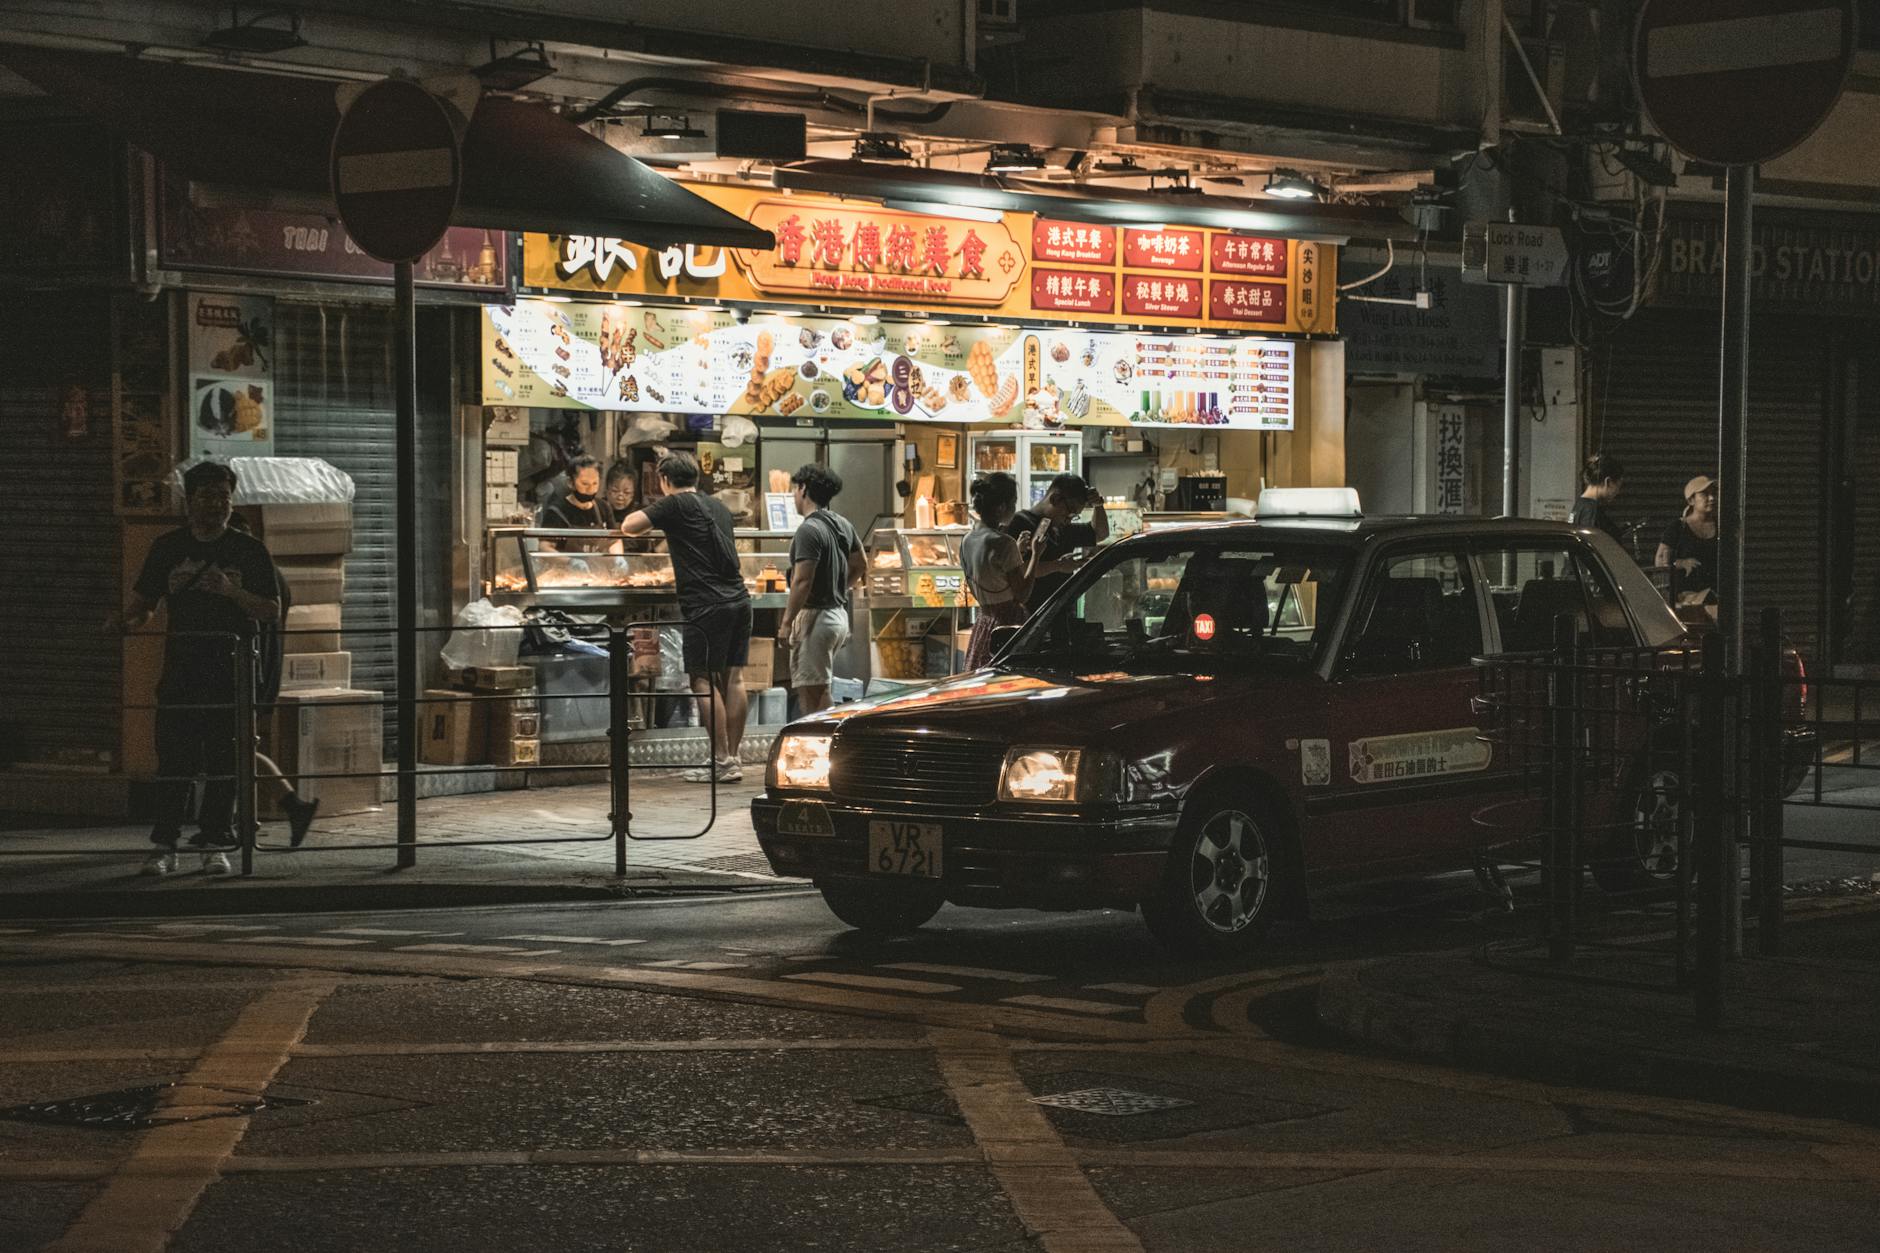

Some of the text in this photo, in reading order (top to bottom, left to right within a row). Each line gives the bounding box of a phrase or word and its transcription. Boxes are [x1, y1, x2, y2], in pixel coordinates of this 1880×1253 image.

[283, 225, 329, 252] THAI
[777, 214, 987, 276] 香港傳統美食
[1047, 226, 1102, 249] 港式早餐
[1137, 233, 1190, 256] 咖啡奶茶
[1490, 230, 1544, 248] Lock Road
[1046, 247, 1102, 260] Hong Kong Breakfast
[1151, 255, 1175, 266] Beverage
[1224, 239, 1274, 262] 午市常餐
[1588, 252, 1611, 269] ADT
[1671, 238, 1767, 277] BRAD
[1222, 260, 1275, 272] Afternoon Regular Set
[1302, 248, 1313, 305] 尖沙咀
[1046, 275, 1101, 298] 精製午餐
[1136, 281, 1189, 303] 秘製串燒
[1223, 285, 1273, 307] 泰式甜品
[1054, 298, 1092, 308] Special Lunch
[1232, 307, 1263, 317] Thai Dessert
[1360, 307, 1389, 330] Wing
[1416, 311, 1452, 329] House
[1195, 620, 1214, 635] TAXI
[798, 807, 810, 823] 4
[892, 823, 921, 852] VR
[877, 849, 935, 876] 6721
